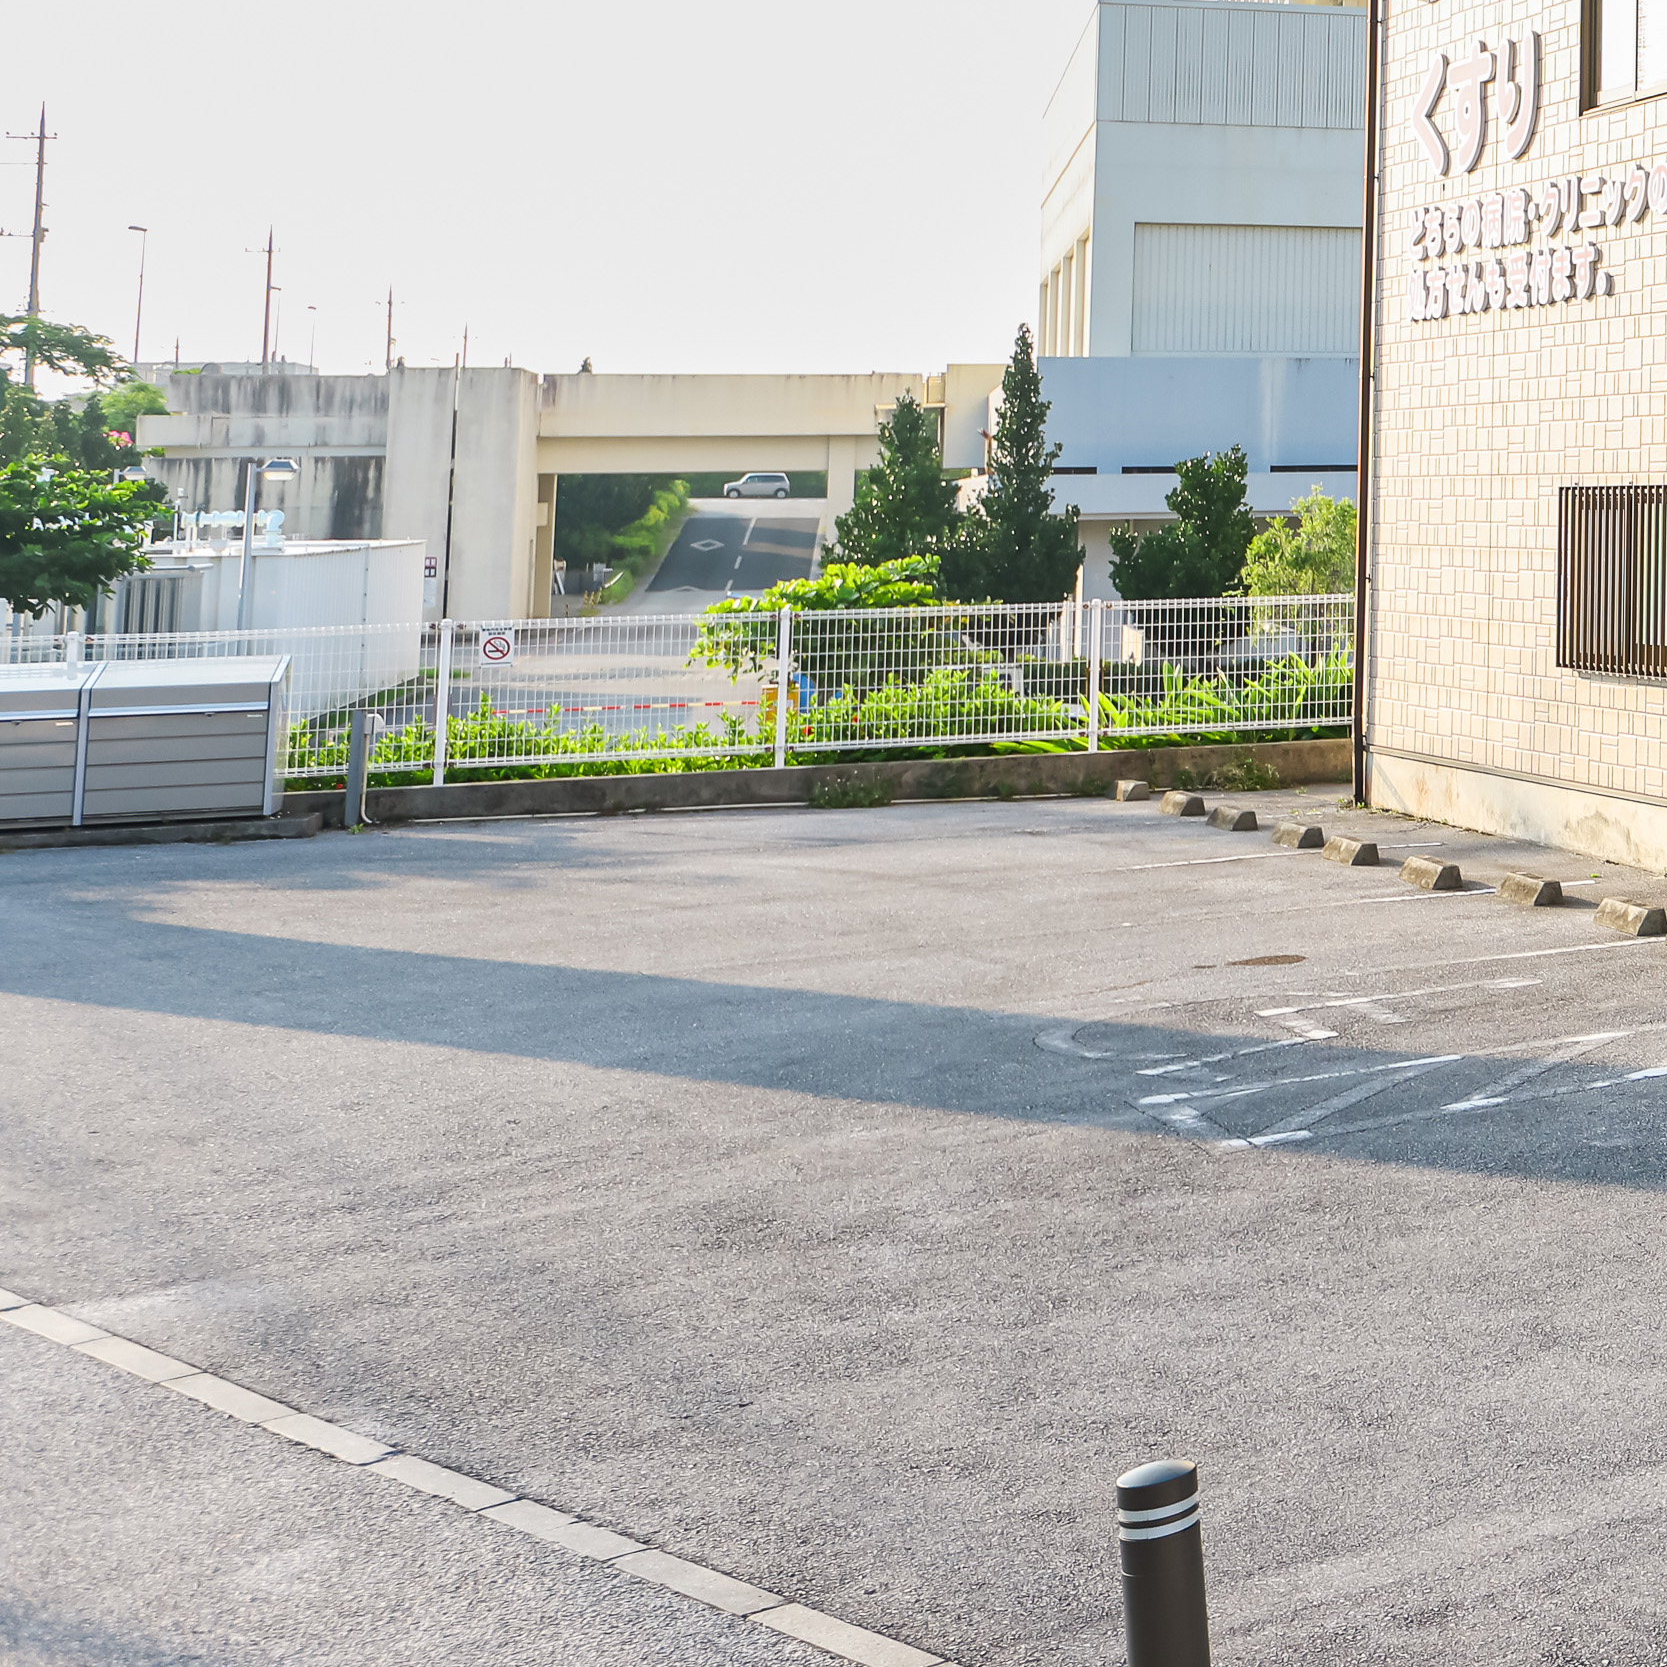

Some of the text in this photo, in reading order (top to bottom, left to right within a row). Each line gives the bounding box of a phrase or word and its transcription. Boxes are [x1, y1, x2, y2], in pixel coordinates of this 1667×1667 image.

[1412, 30, 1541, 177] くすり
[1408, 241, 1615, 322] 処方せんも受付ます。
